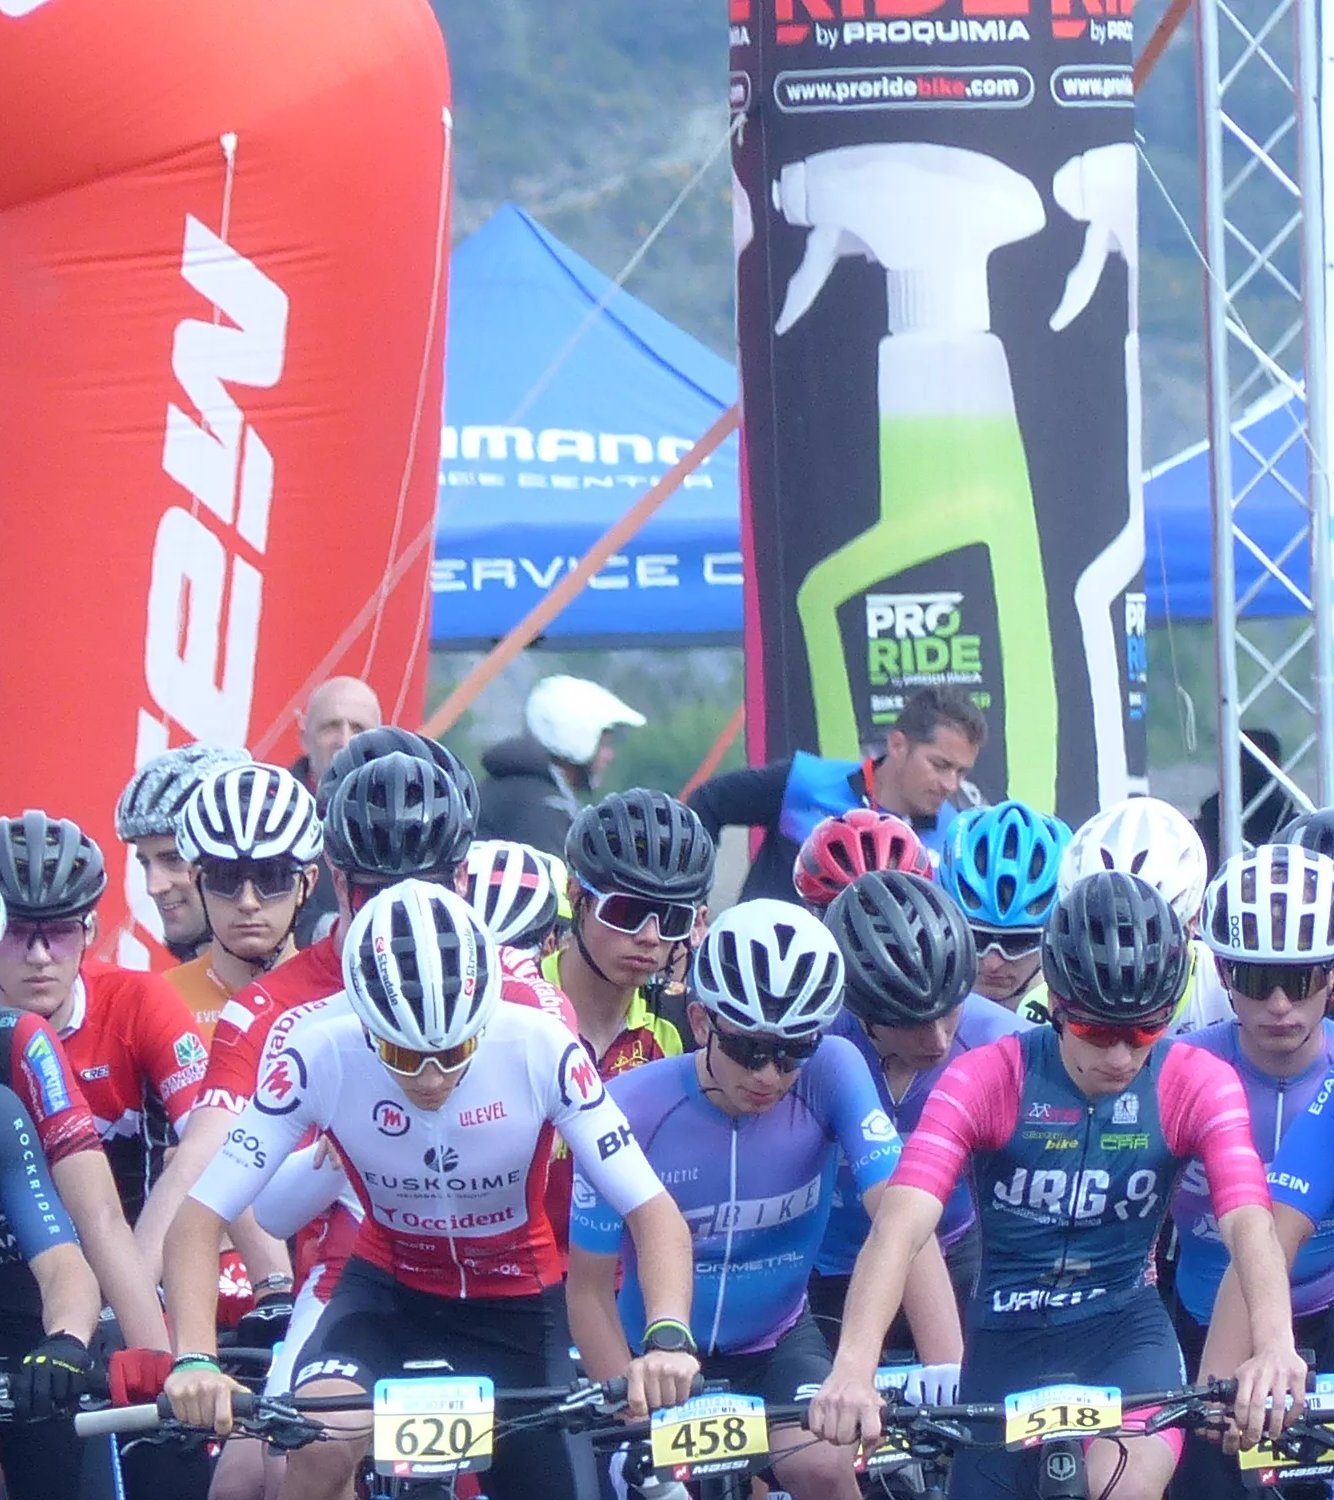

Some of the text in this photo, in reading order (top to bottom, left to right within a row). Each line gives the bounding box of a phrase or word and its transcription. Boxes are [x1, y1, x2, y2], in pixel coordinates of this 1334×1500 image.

[814, 19, 1030, 51] by PROQUIMIA
[785, 76, 1020, 103] www.proridebike.com
[866, 602, 961, 638] PRO
[869, 634, 983, 674] RIDE
[1228, 914, 1241, 948] POC
[375, 952, 399, 1007] Stradale
[1045, 1139, 1079, 1151] bike
[13, 1117, 62, 1235] ROCKRIDER
[364, 1170, 521, 1192] EUSKOIME
[993, 1167, 1110, 1219] JRG
[402, 1206, 515, 1231] Occident
[722, 1179, 817, 1229] BIKE
[295, 1359, 359, 1387] BH
[395, 1418, 472, 1456] 620
[670, 1416, 749, 1459] 458
[1026, 1405, 1102, 1435] 518
